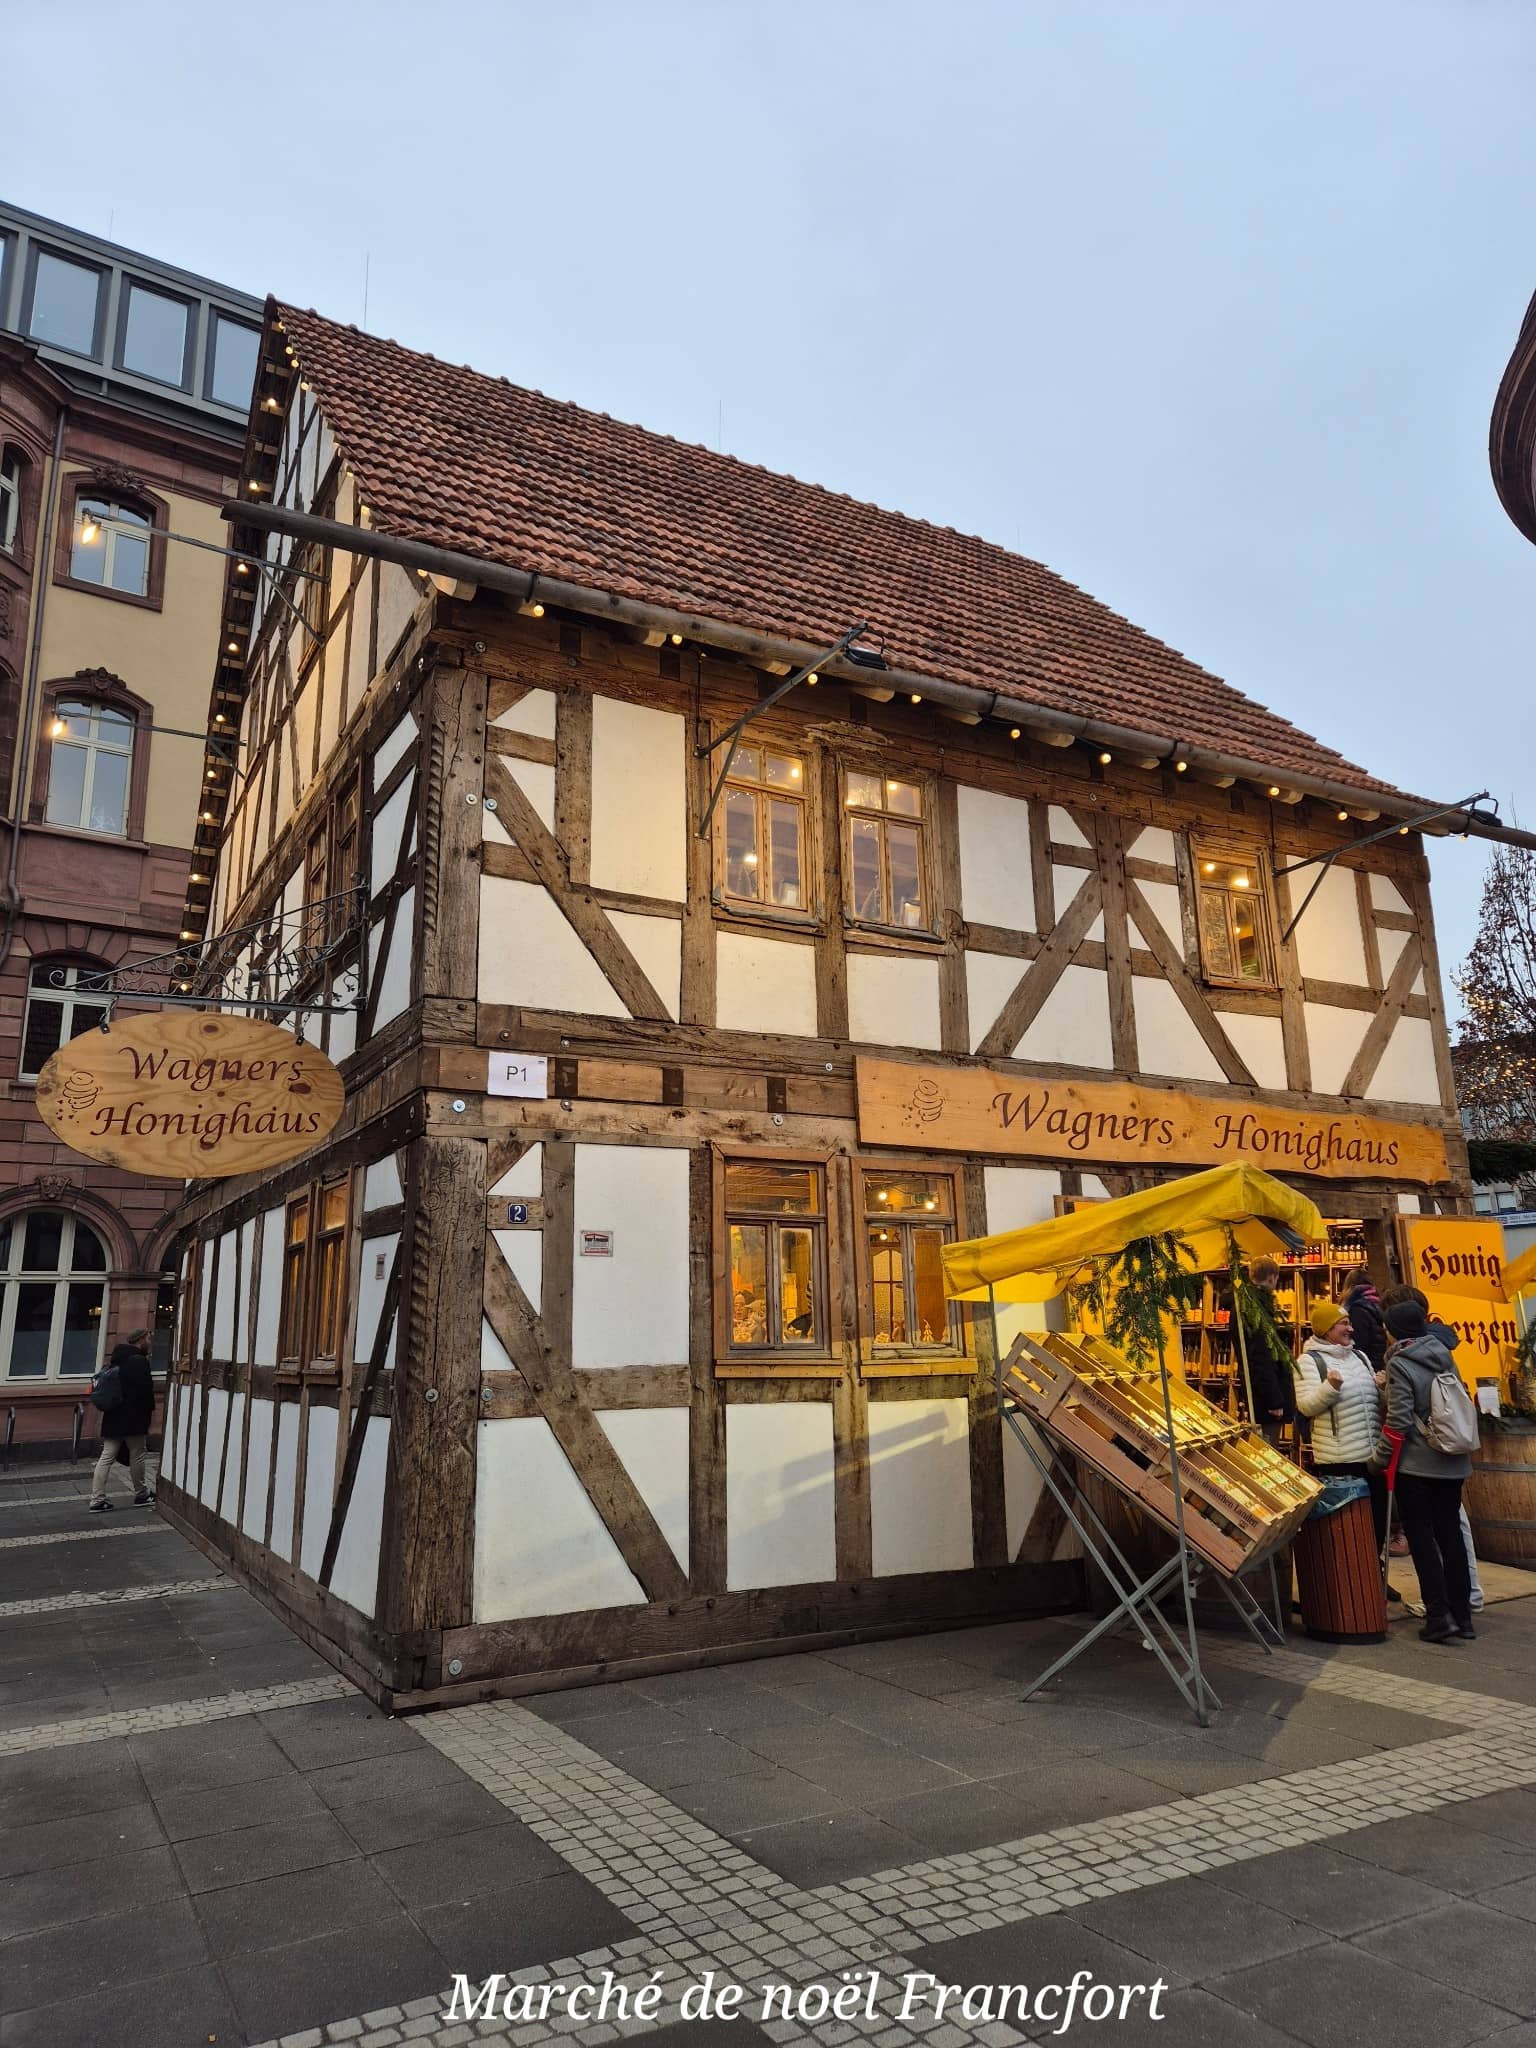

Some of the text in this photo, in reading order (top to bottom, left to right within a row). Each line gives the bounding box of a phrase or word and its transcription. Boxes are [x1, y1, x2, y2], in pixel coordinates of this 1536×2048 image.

[118, 1046, 304, 1092] Wagners
[506, 1065, 527, 1082] P1
[90, 1101, 321, 1146] Honighaus
[992, 1090, 1399, 1171] Wagners Honighaus
[514, 1205, 522, 1221] 2
[1421, 1244, 1503, 1288] Honig
